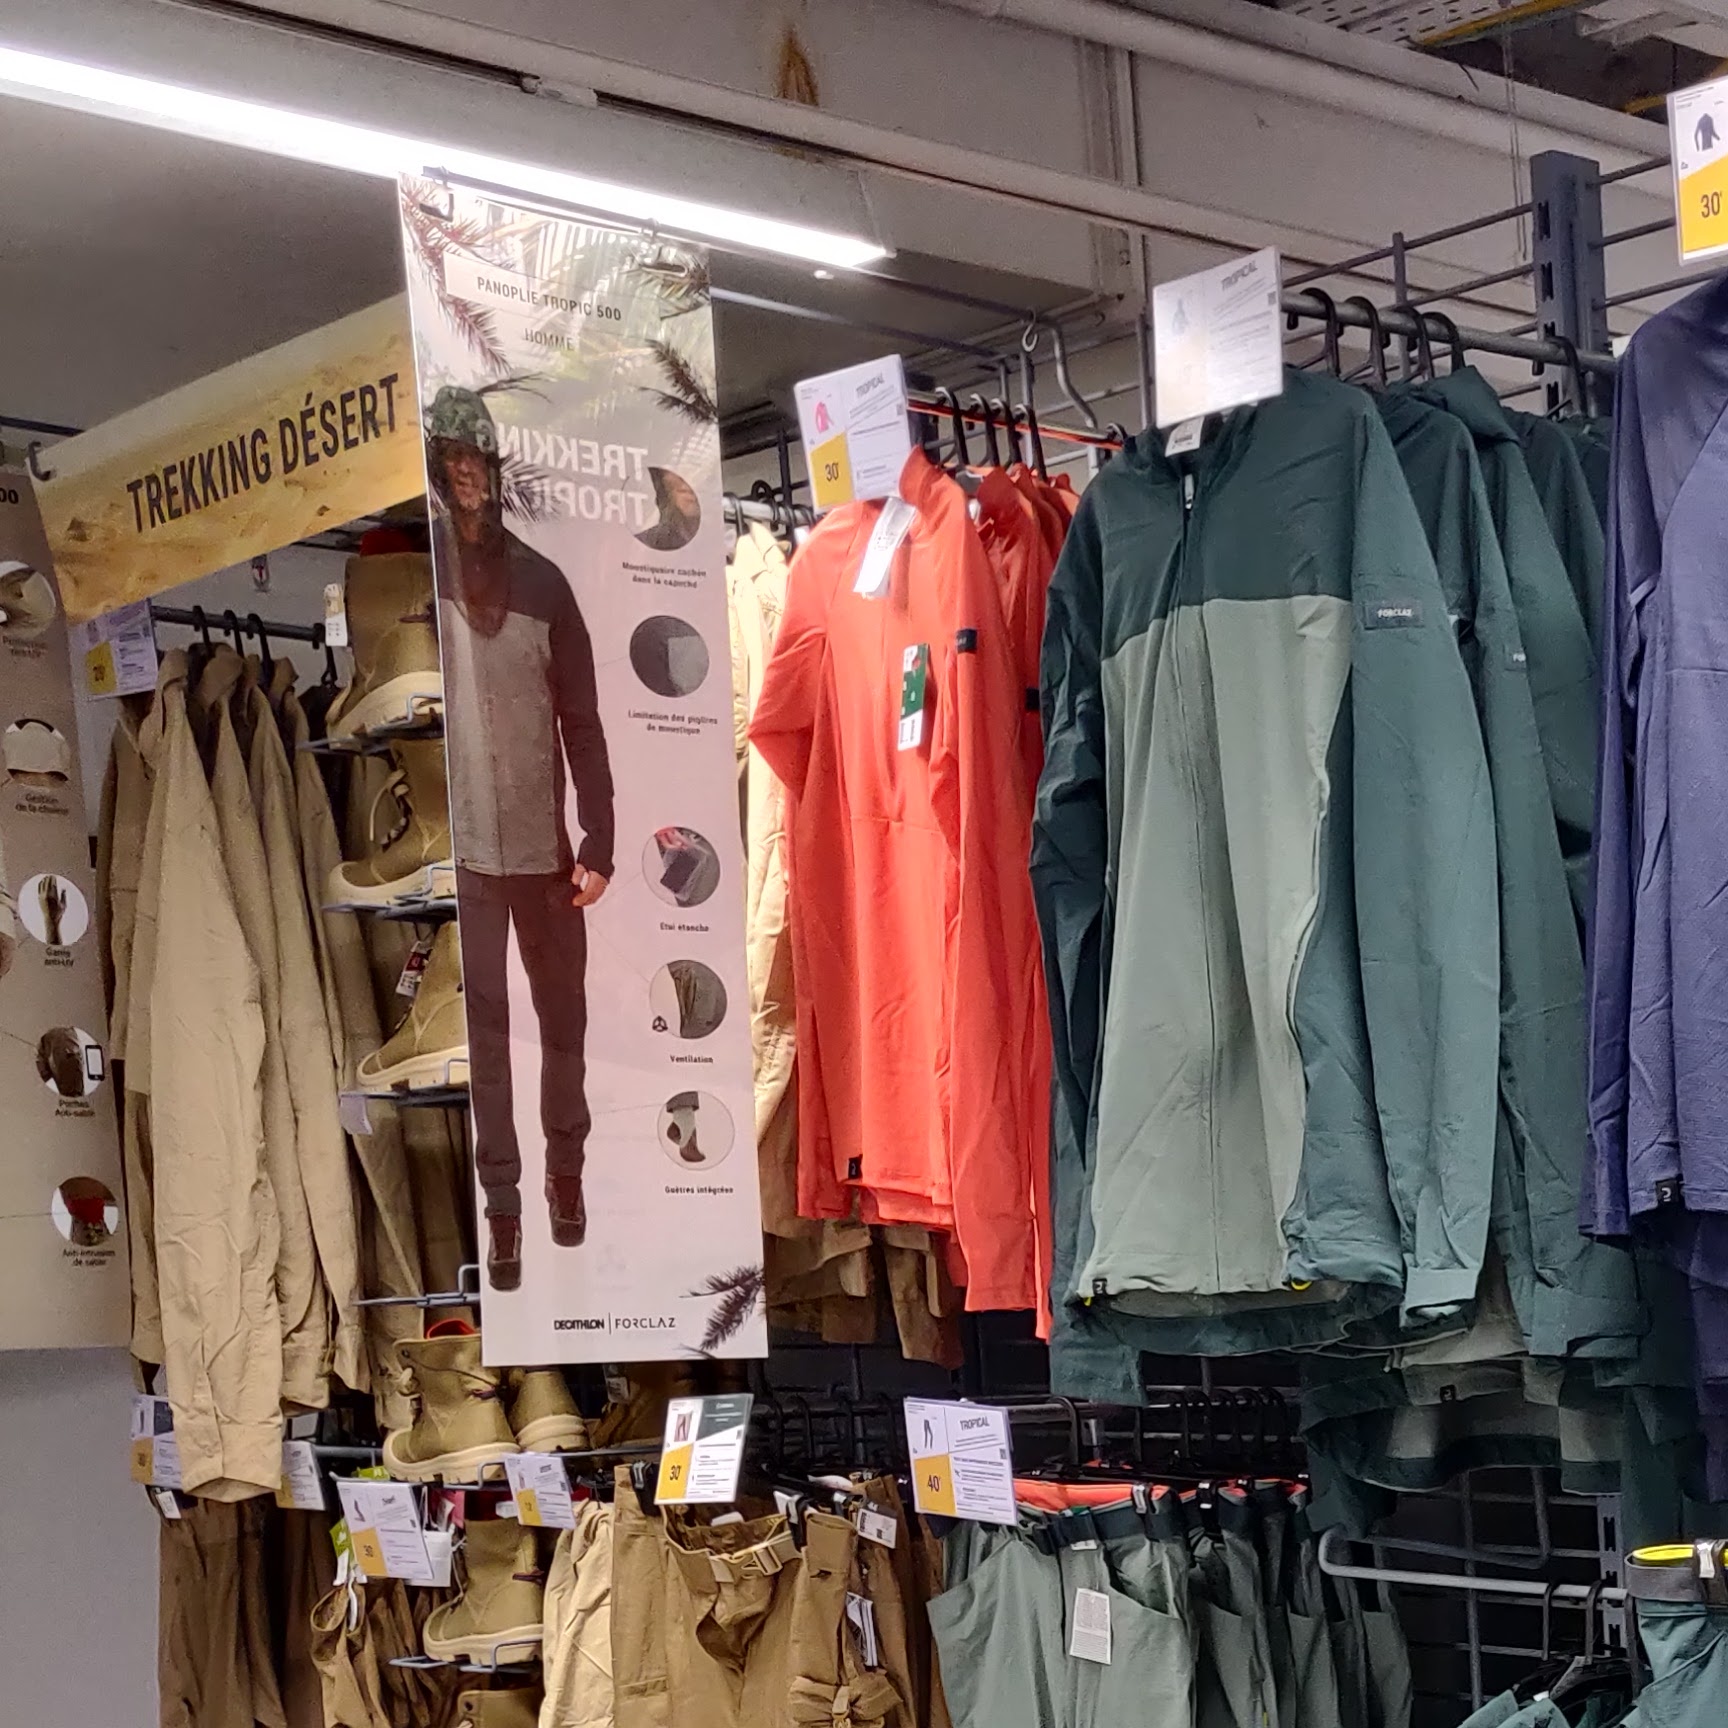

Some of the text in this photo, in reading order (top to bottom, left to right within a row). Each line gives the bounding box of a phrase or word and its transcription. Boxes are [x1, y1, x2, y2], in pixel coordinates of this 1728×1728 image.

[477, 276, 622, 321] PANOPLIE TROPIC 500
[525, 328, 575, 351] HOMME
[127, 373, 399, 534] TREKKING DÉSERT
[670, 1055, 714, 1065] Ventilation
[554, 1316, 676, 1331] DECATHLON FORCLAZ
[960, 1416, 990, 1432] TROPICAL
